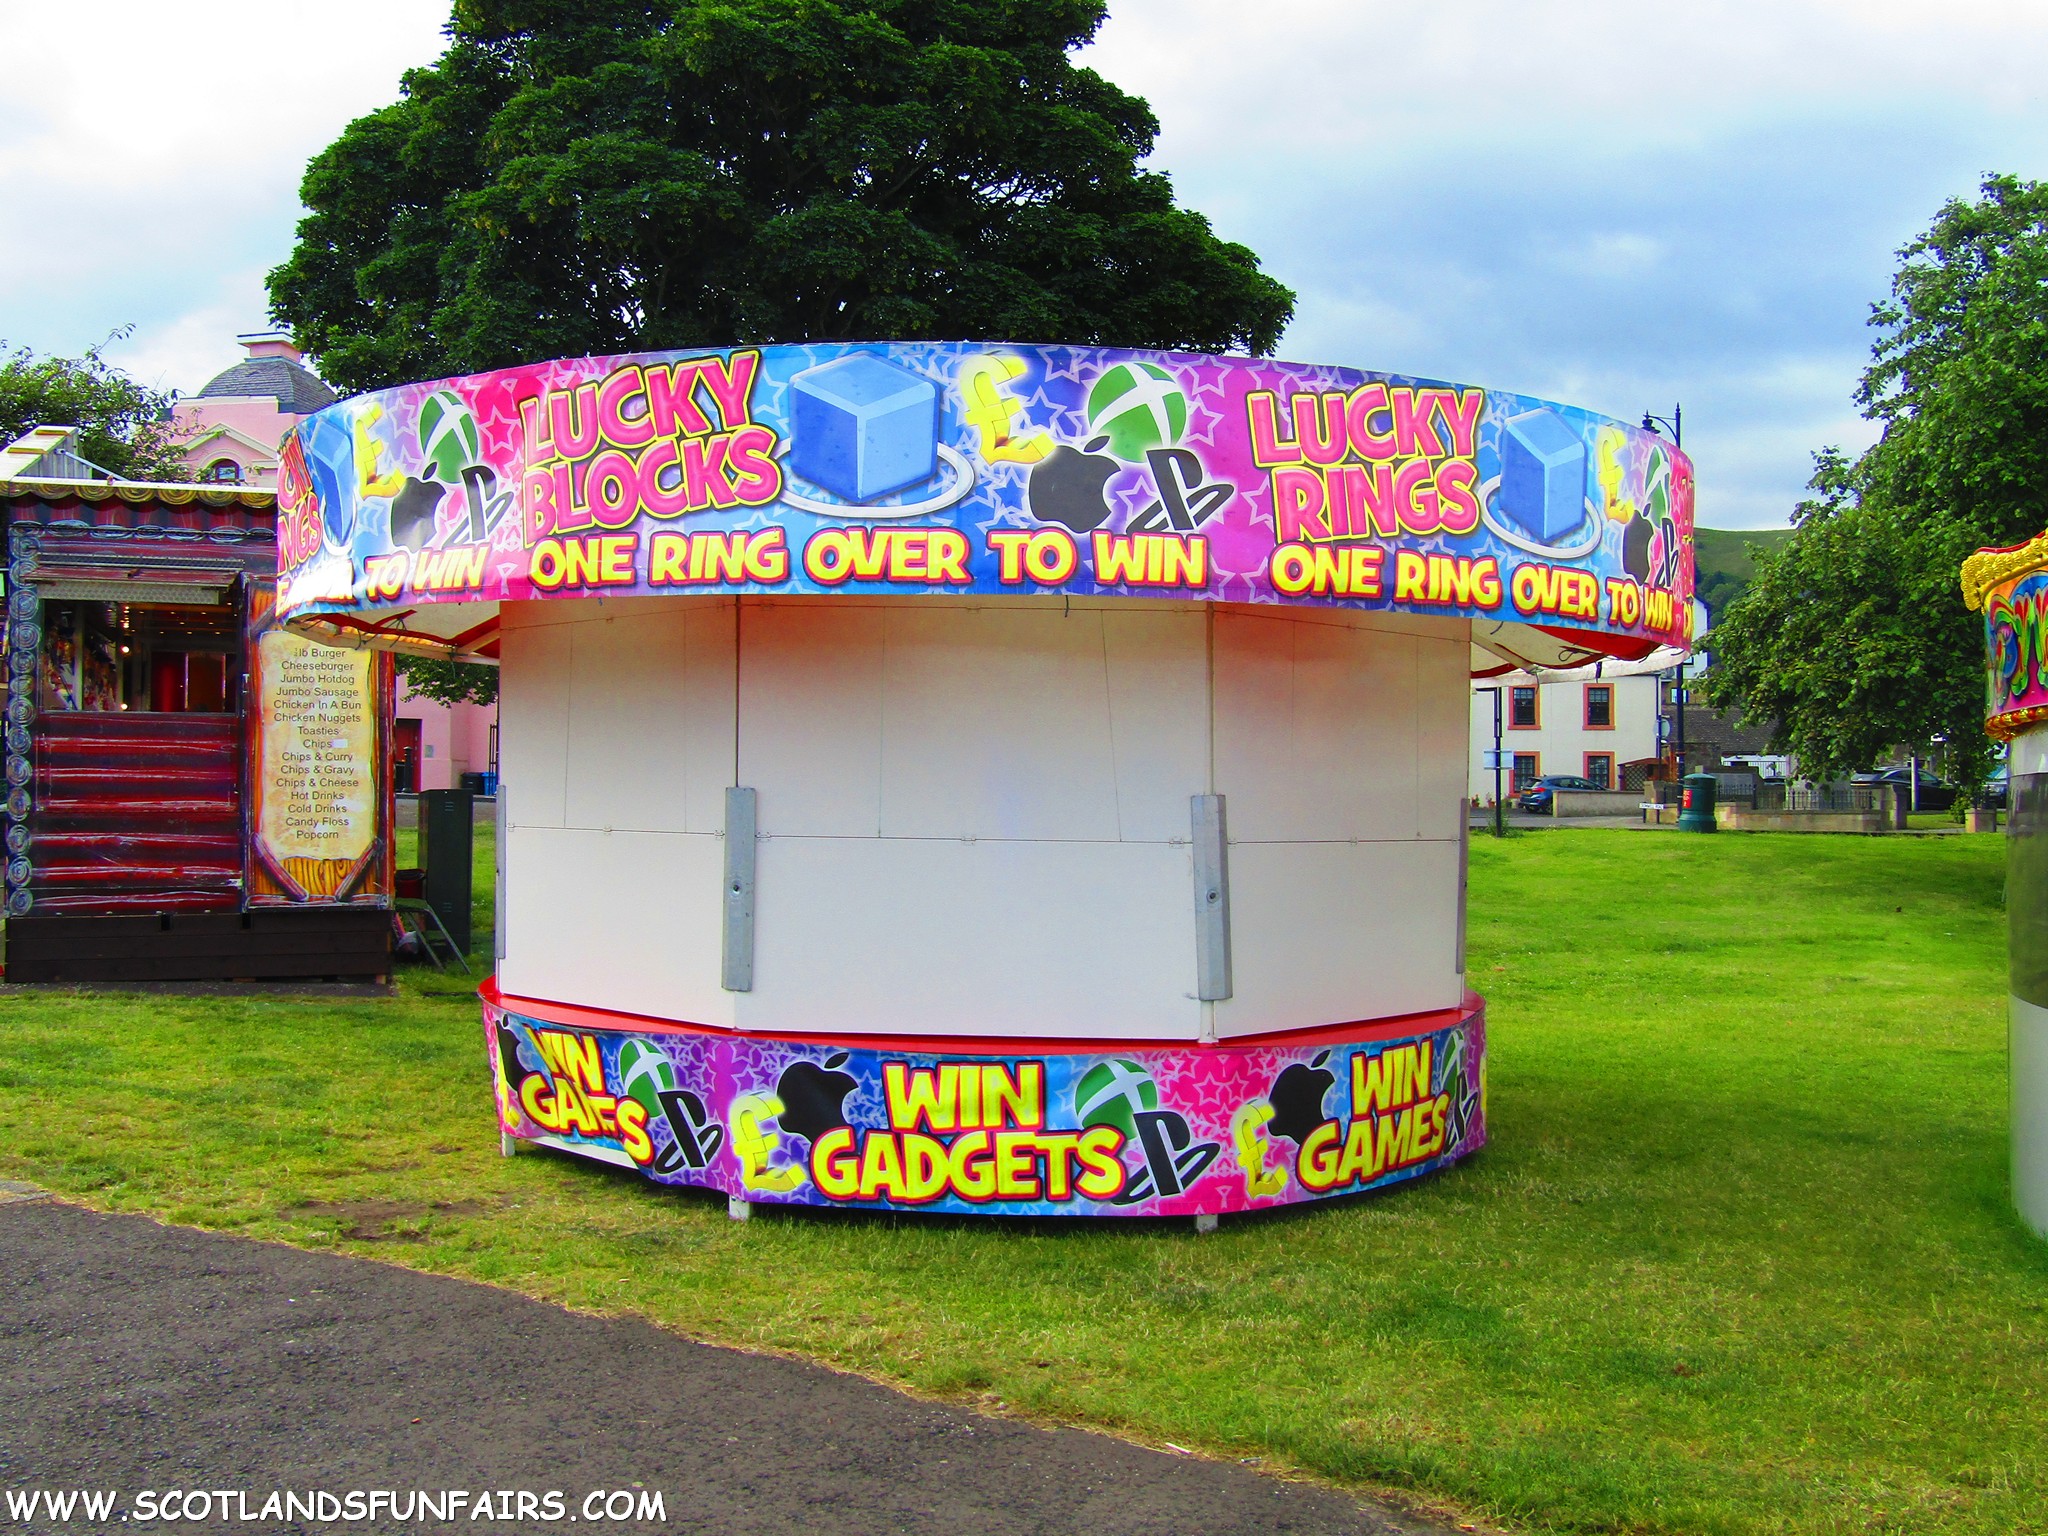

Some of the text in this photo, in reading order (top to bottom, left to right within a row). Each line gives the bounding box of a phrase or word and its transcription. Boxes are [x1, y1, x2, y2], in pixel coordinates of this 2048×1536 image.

[520, 349, 761, 466] LUCKY
[1247, 382, 1484, 468] LUCKY
[523, 427, 781, 548] BLOCKS
[1272, 457, 1480, 544] RINGS
[277, 490, 323, 578] NGS
[530, 527, 1208, 591] ONE RING OVER TO WIN
[364, 553, 410, 600] TO
[413, 545, 488, 595] WIN
[1270, 541, 1384, 598] ONE
[1395, 550, 1501, 610] RING
[1510, 563, 1599, 624] OVER
[1606, 577, 1640, 628] TO
[1643, 584, 1675, 633] WIN
[311, 649, 346, 659] Burger
[281, 661, 354, 672] Cheeseburger
[281, 675, 355, 685] Jumbo Hotdog
[276, 687, 358, 698] Jumbo Sausage
[274, 700, 361, 709] Chicken In A Bun
[274, 713, 360, 724] Chicken Nuggets
[298, 726, 340, 735] Toasties
[303, 739, 332, 749] Chips
[282, 752, 352, 762] Chips & Curry
[281, 765, 354, 775] Chips & Gravy
[276, 778, 359, 788] Chips & Cheese
[312, 791, 344, 799] Drinks
[288, 804, 347, 812] Cold Drinks
[286, 817, 349, 828] Candy Floss
[297, 830, 339, 840] Popcorn
[1349, 1036, 1434, 1118] WIN
[881, 1060, 1046, 1133] WIN
[1296, 1092, 1450, 1193] GAMES
[810, 1124, 1128, 1204] GADGETS
